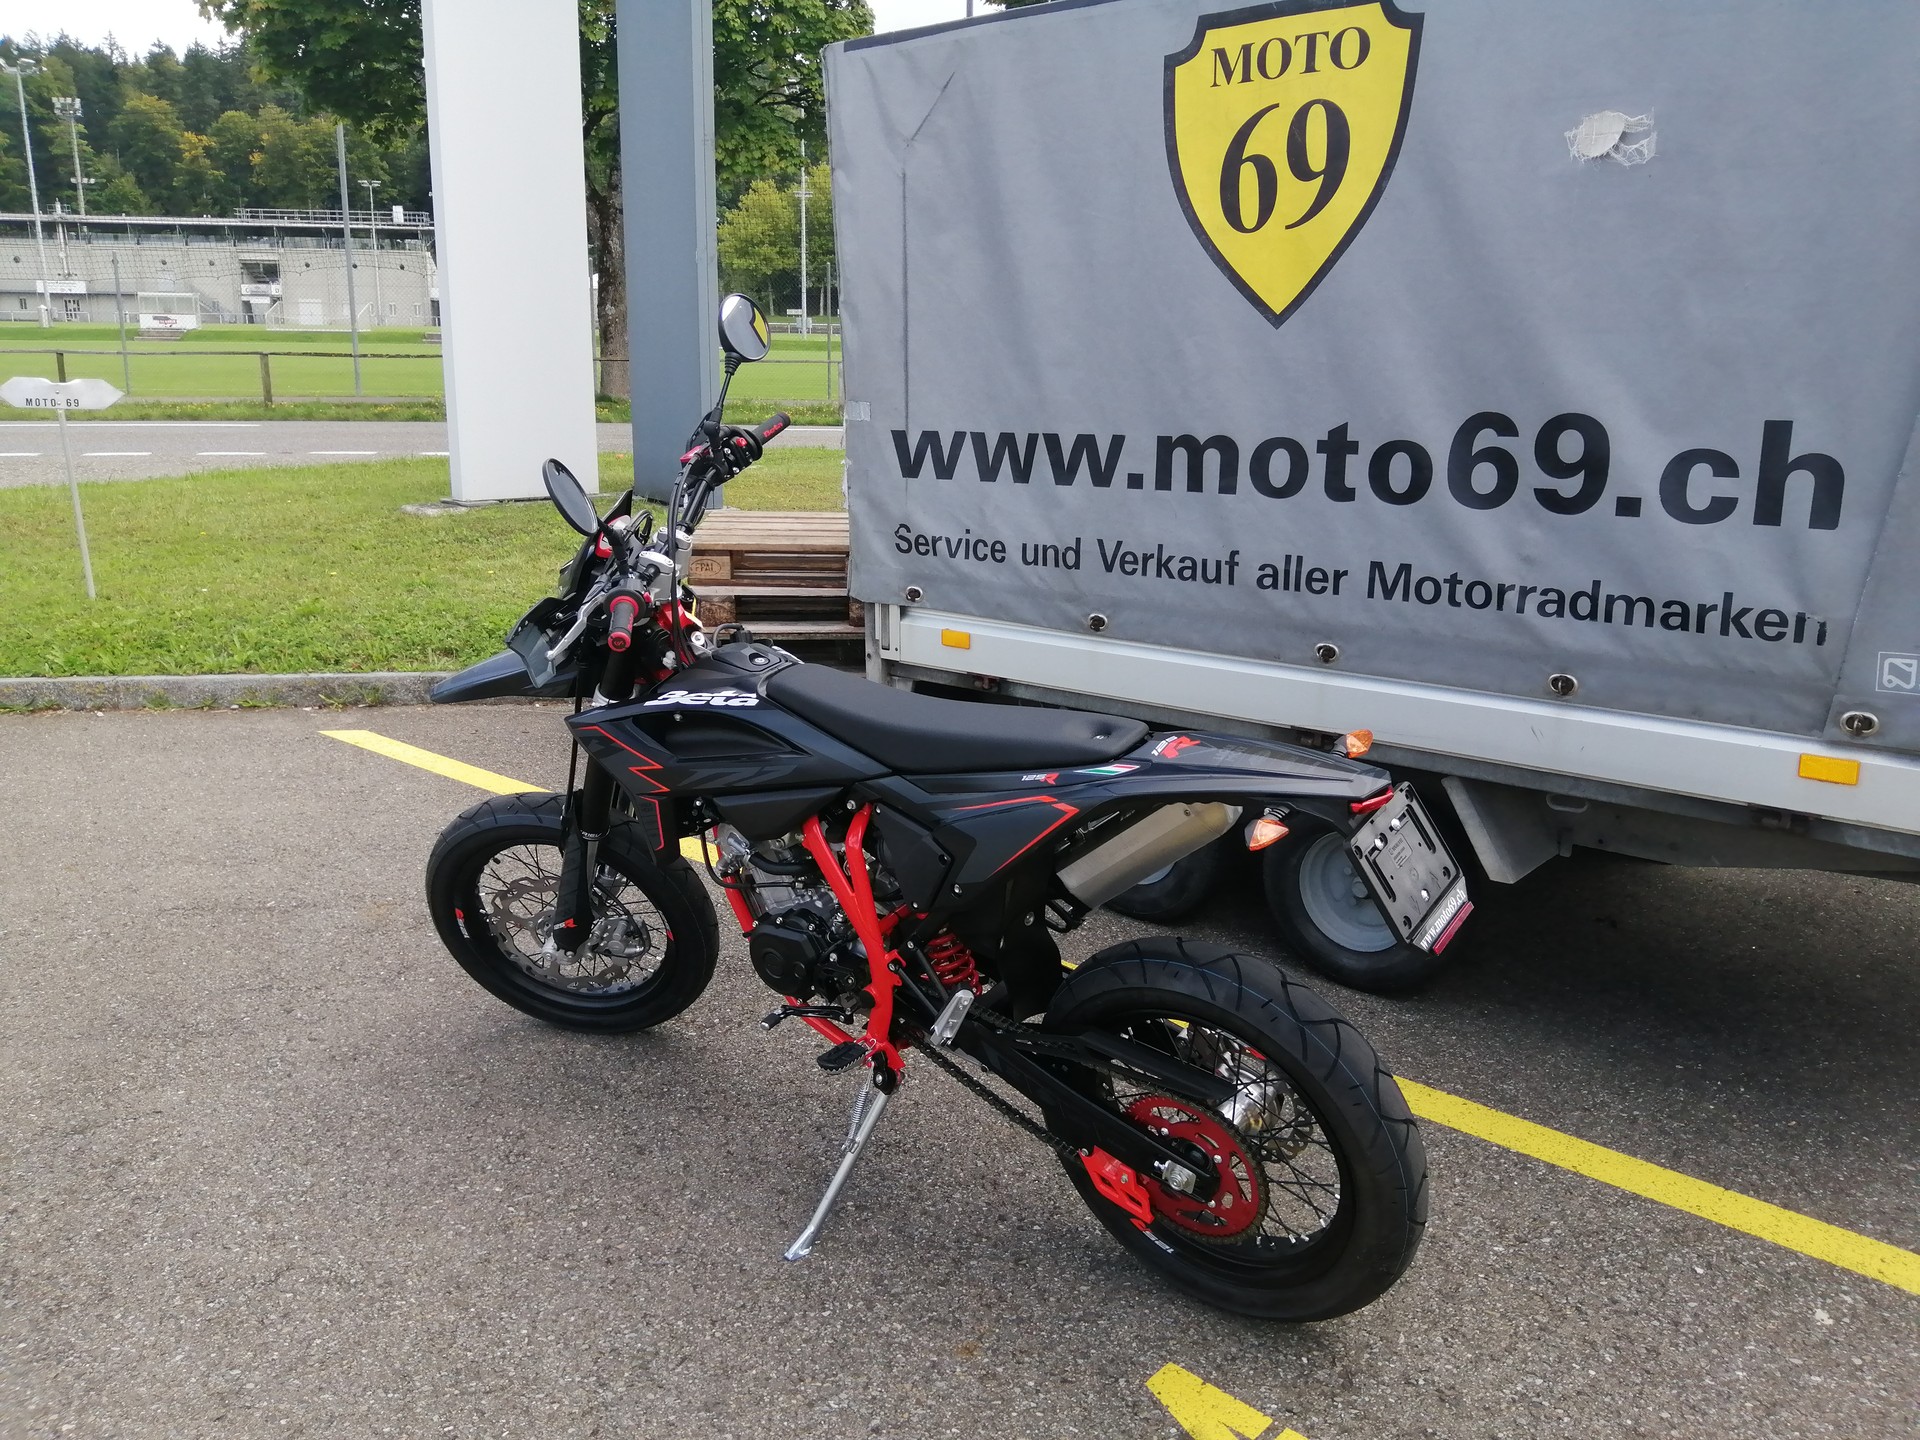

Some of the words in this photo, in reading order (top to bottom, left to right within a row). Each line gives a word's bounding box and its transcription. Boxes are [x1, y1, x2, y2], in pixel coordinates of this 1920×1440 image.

[1210, 26, 1371, 88] MOTO
[1219, 98, 1351, 234] 69
[25, 398, 57, 407] MOTO
[66, 399, 80, 407] 69
[890, 411, 1845, 531] www.moto69.ch
[894, 523, 1007, 564] Service
[1021, 537, 1082, 570] und
[1096, 538, 1240, 586] Verkauf
[1256, 554, 1349, 596] aller
[1367, 560, 1828, 647] Motorradmarken
[643, 690, 759, 706] Beta
[1420, 888, 1467, 949] www.moto69.ch
